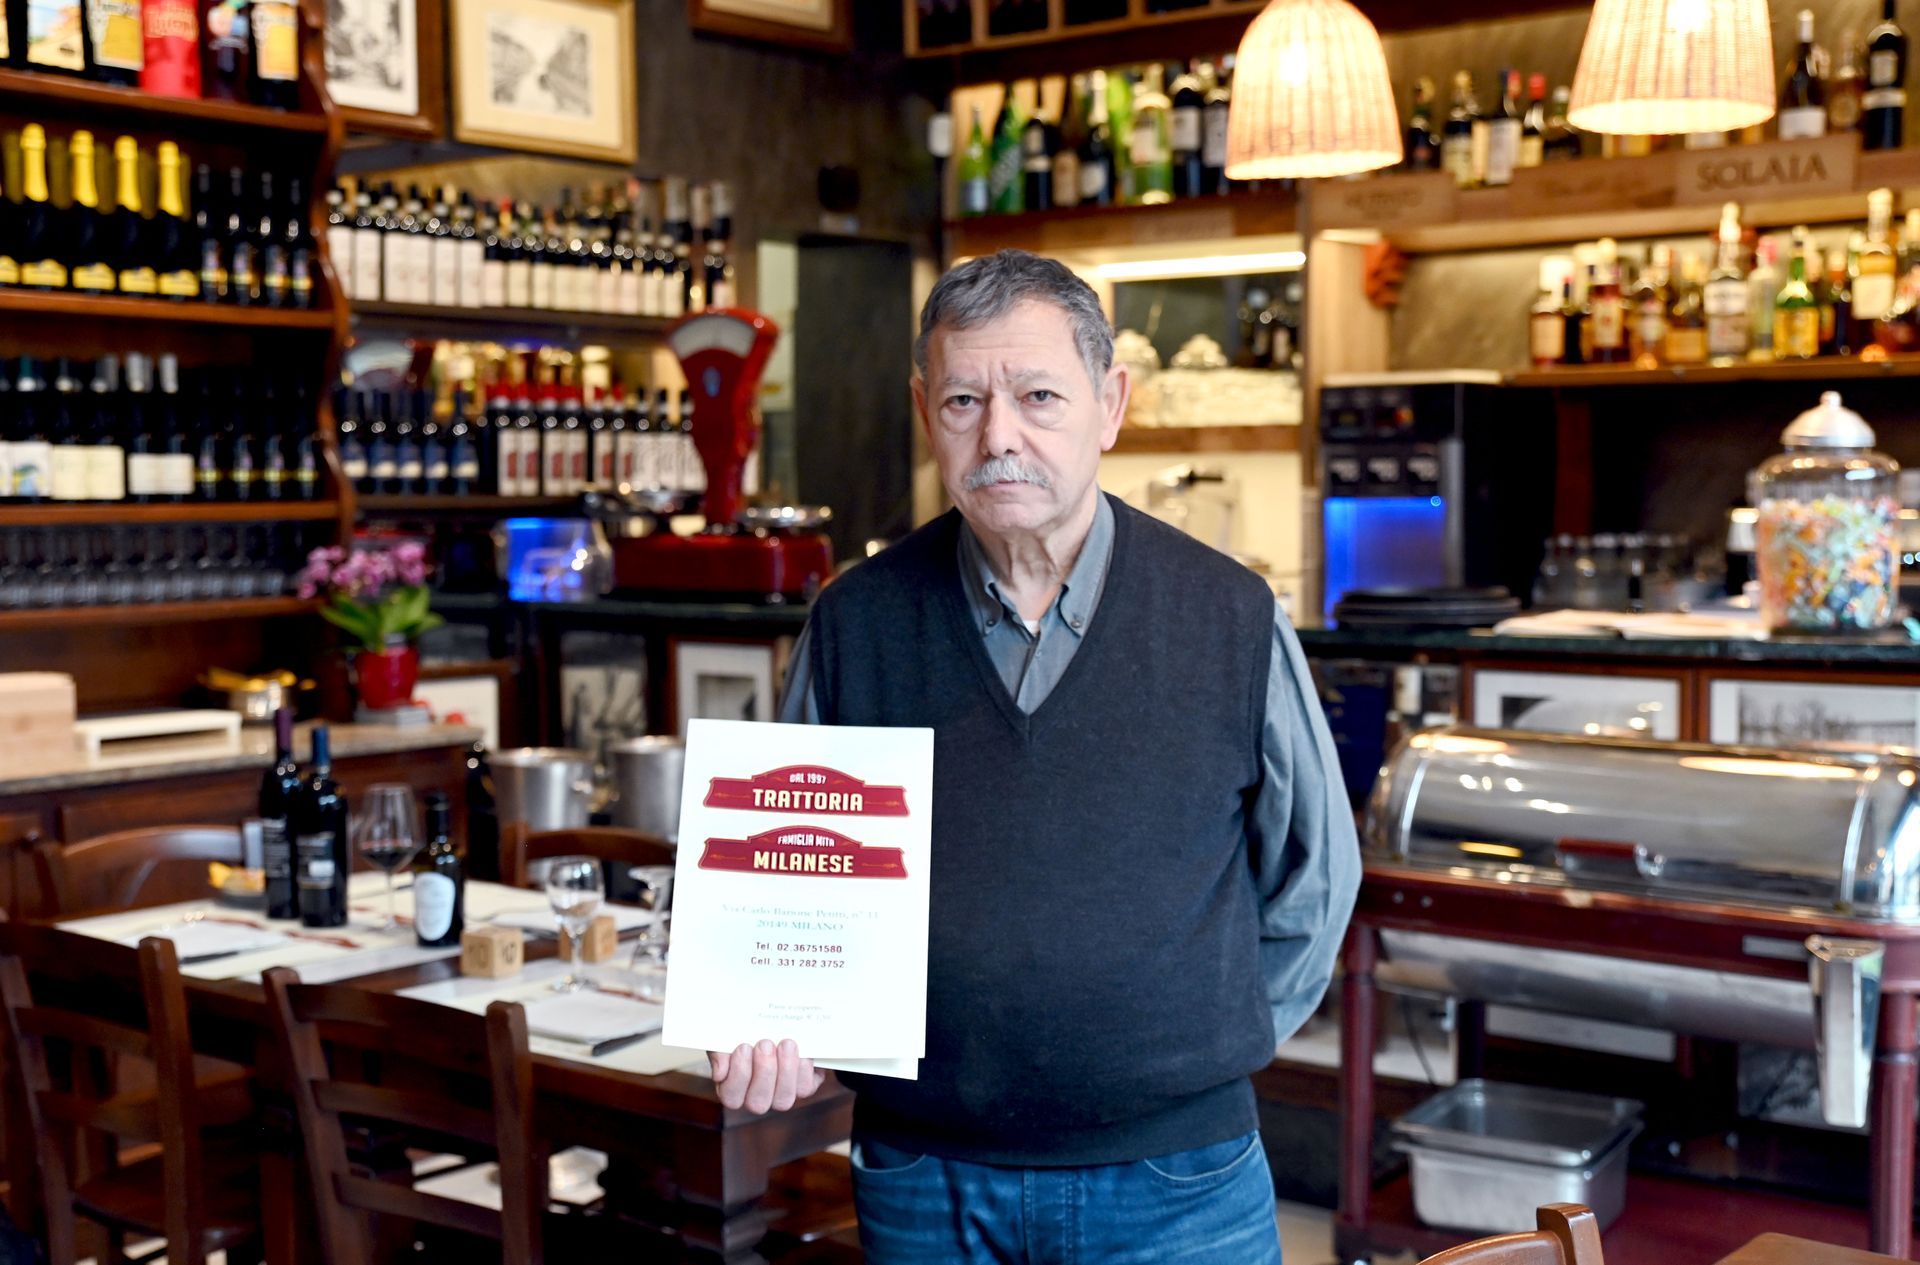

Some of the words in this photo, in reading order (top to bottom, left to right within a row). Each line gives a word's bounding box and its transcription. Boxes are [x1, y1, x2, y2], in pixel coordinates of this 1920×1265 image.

[1697, 152, 1828, 192] SOLAIA
[789, 773, 805, 784] DAL
[807, 773, 827, 785] 1997
[752, 788, 864, 812] TRATTORIA
[777, 833, 815, 847] FAMIGLIA
[815, 835, 836, 848] MITA
[753, 851, 855, 874] MILANESE
[791, 921, 844, 931] MILANO
[755, 942, 773, 951] Tel.
[750, 957, 773, 966] Cell.
[777, 958, 796, 967] 331
[799, 959, 818, 968] 282
[820, 959, 846, 969] 3752
